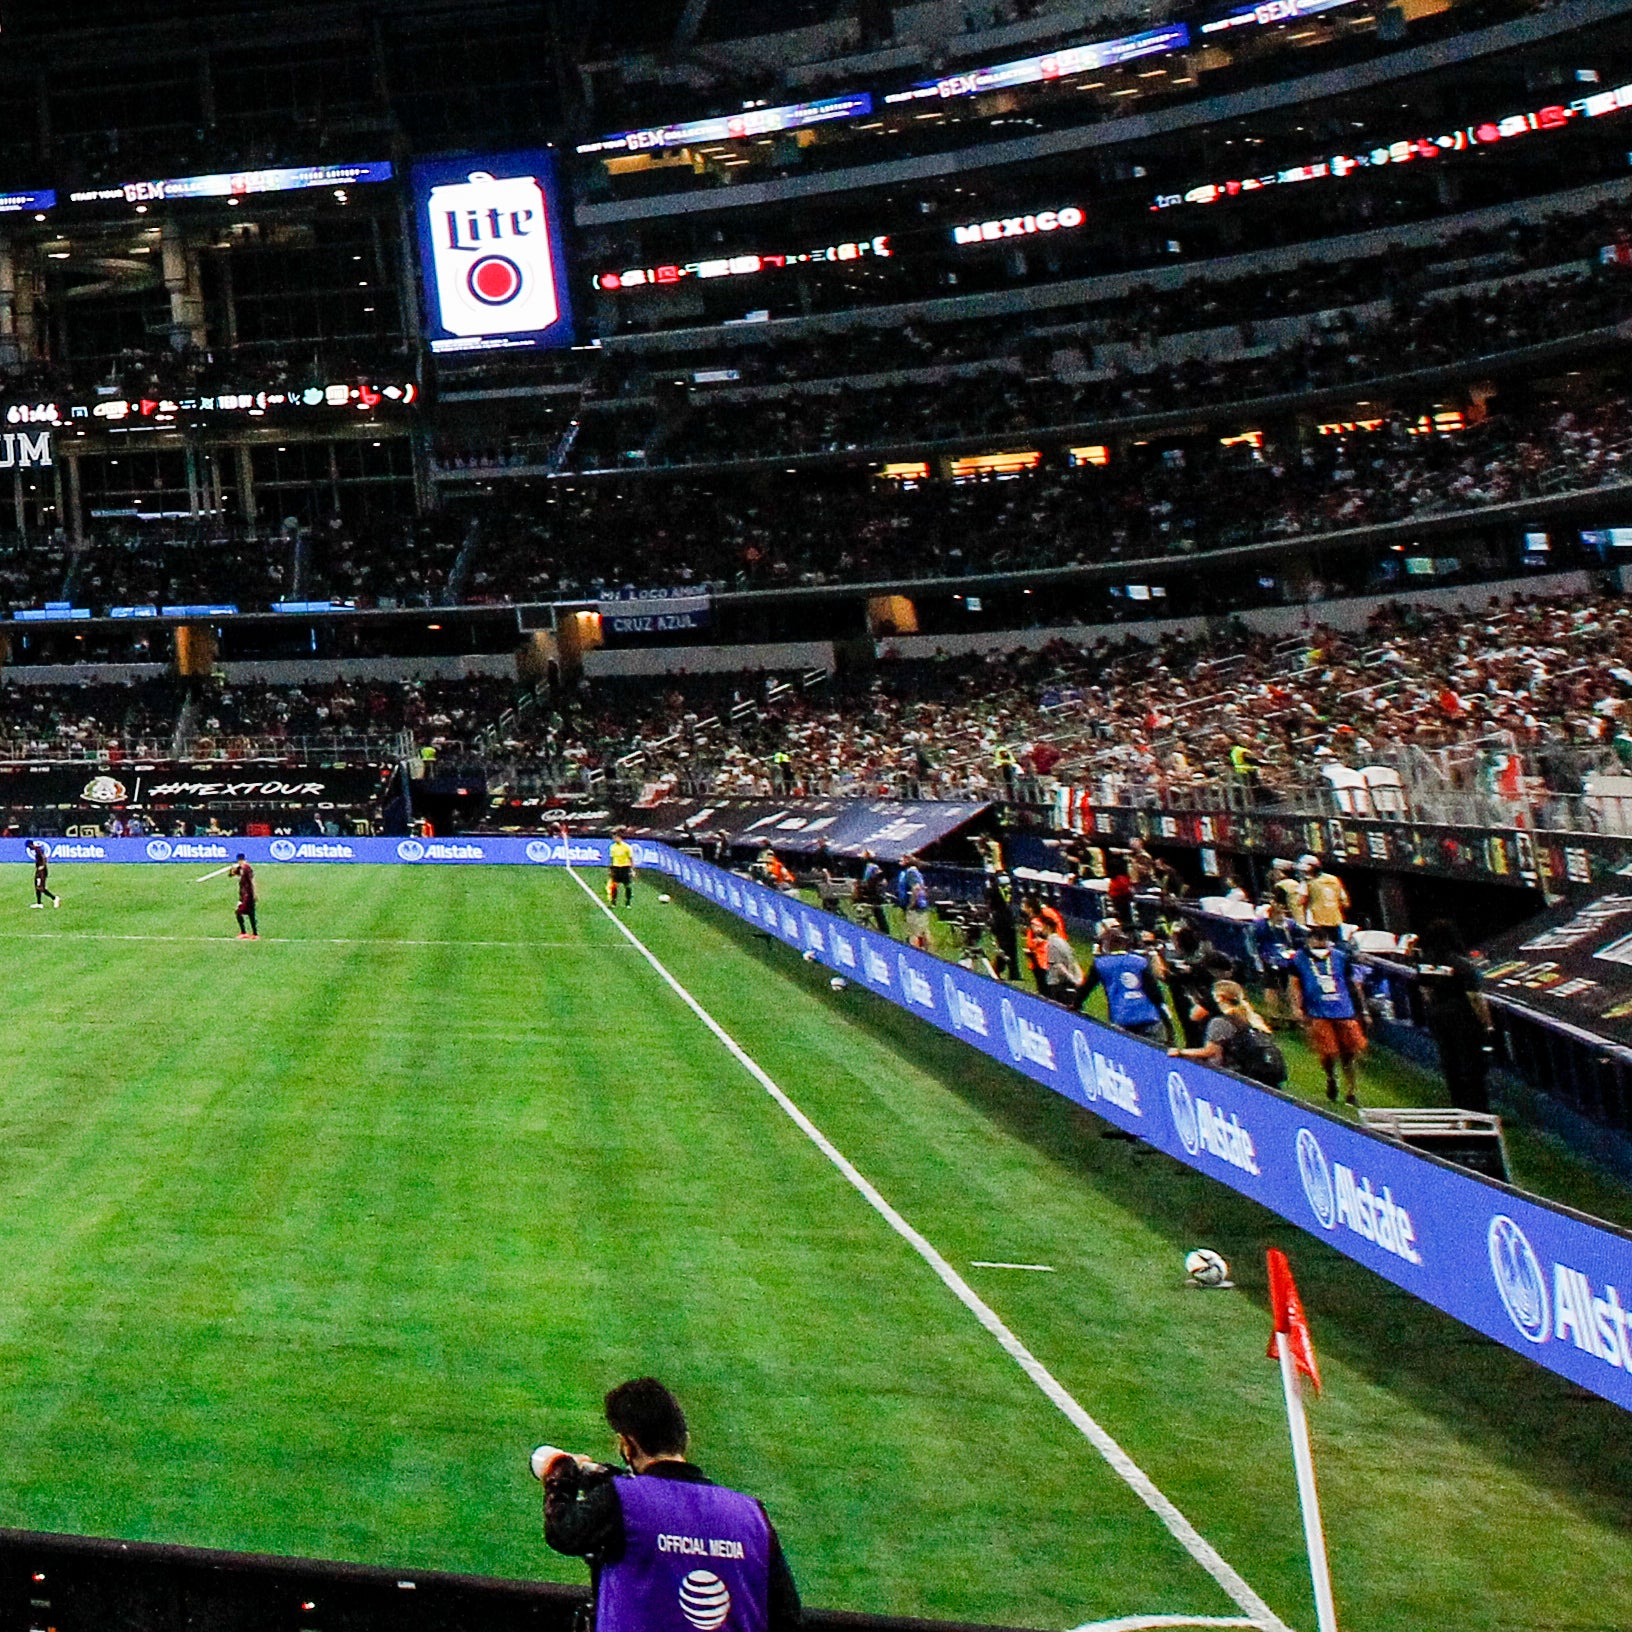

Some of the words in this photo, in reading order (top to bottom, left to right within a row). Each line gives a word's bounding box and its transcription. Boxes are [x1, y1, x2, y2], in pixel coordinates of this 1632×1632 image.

[937, 74, 979, 98] GEM
[625, 129, 666, 151] GEM
[122, 181, 166, 202] GEM
[443, 208, 533, 252] Lite
[953, 206, 1087, 245] MEXICO
[628, 589, 668, 600] LOCO
[614, 617, 652, 632] CRUZ
[657, 614, 697, 630] AZUL
[147, 779, 326, 797] #MEXTOUR
[51, 844, 106, 859] Allstate
[172, 844, 228, 859] Allstate
[296, 844, 355, 859] Allstate
[424, 844, 484, 860] Allstate
[1194, 1096, 1262, 1176] Allstate
[1334, 1161, 1423, 1266] Allstate
[657, 1533, 709, 1557] OFFICIAL
[709, 1538, 746, 1560] MEDIA
